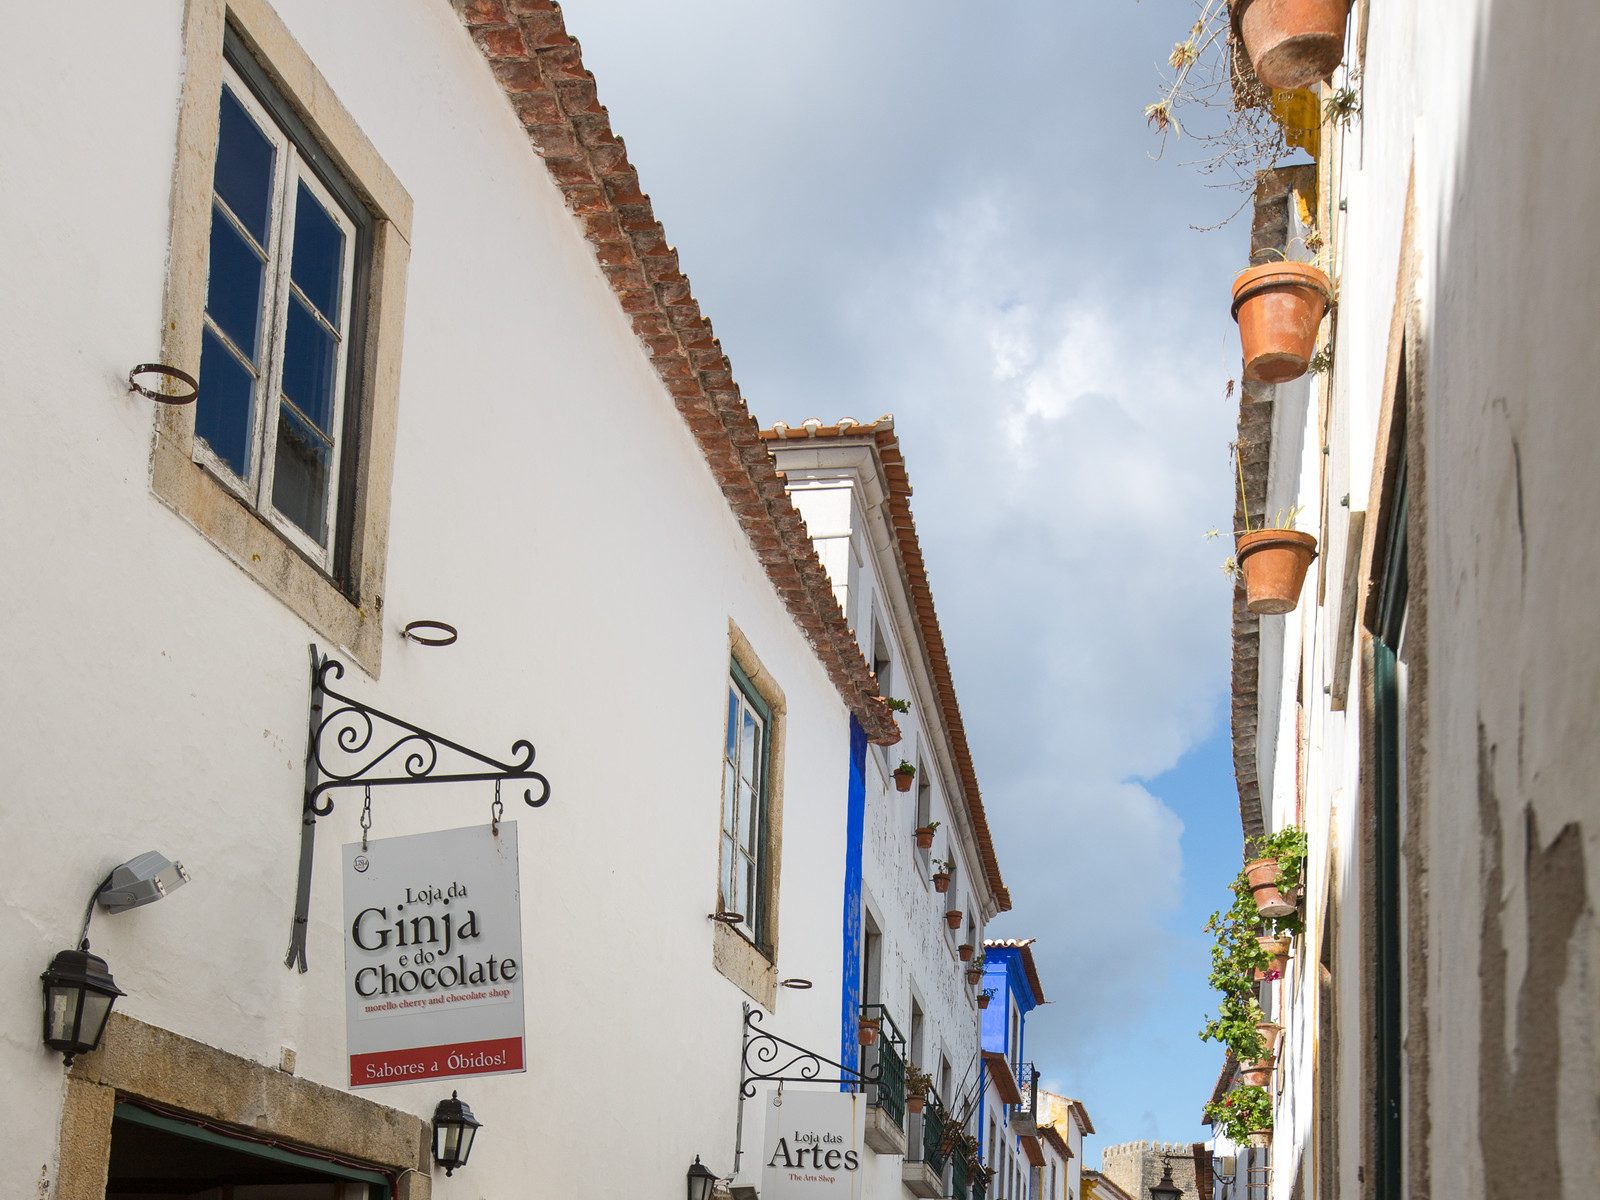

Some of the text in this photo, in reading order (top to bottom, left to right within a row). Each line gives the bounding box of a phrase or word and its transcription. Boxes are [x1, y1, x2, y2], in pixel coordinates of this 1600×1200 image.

[405, 882, 468, 905] Loja da
[352, 898, 480, 955] Ginja
[399, 948, 435, 967] e do
[354, 954, 518, 998] Chocolate
[365, 988, 511, 1013] morello cherry and chocolate shop
[366, 1050, 507, 1079] Sabores a Óbidos!
[794, 1131, 843, 1145] Loja das
[767, 1137, 859, 1171] Artes
[789, 1173, 836, 1184] The Arts Shop
